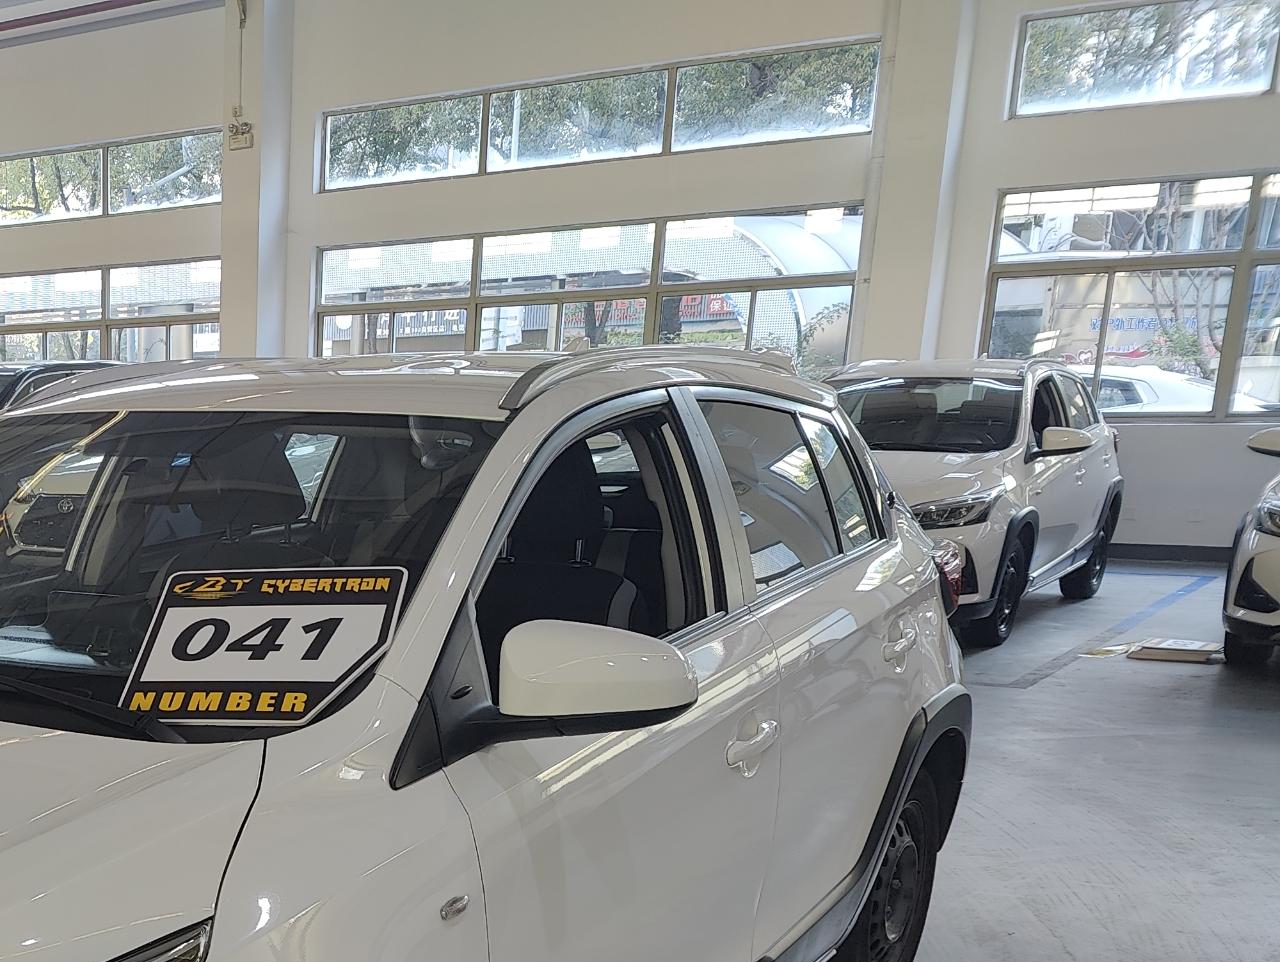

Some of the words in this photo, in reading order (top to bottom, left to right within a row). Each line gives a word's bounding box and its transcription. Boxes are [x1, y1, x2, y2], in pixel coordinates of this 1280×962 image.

[261, 577, 390, 594] CYBERTRON
[171, 617, 344, 662] 041
[128, 691, 308, 713] NUMBER
